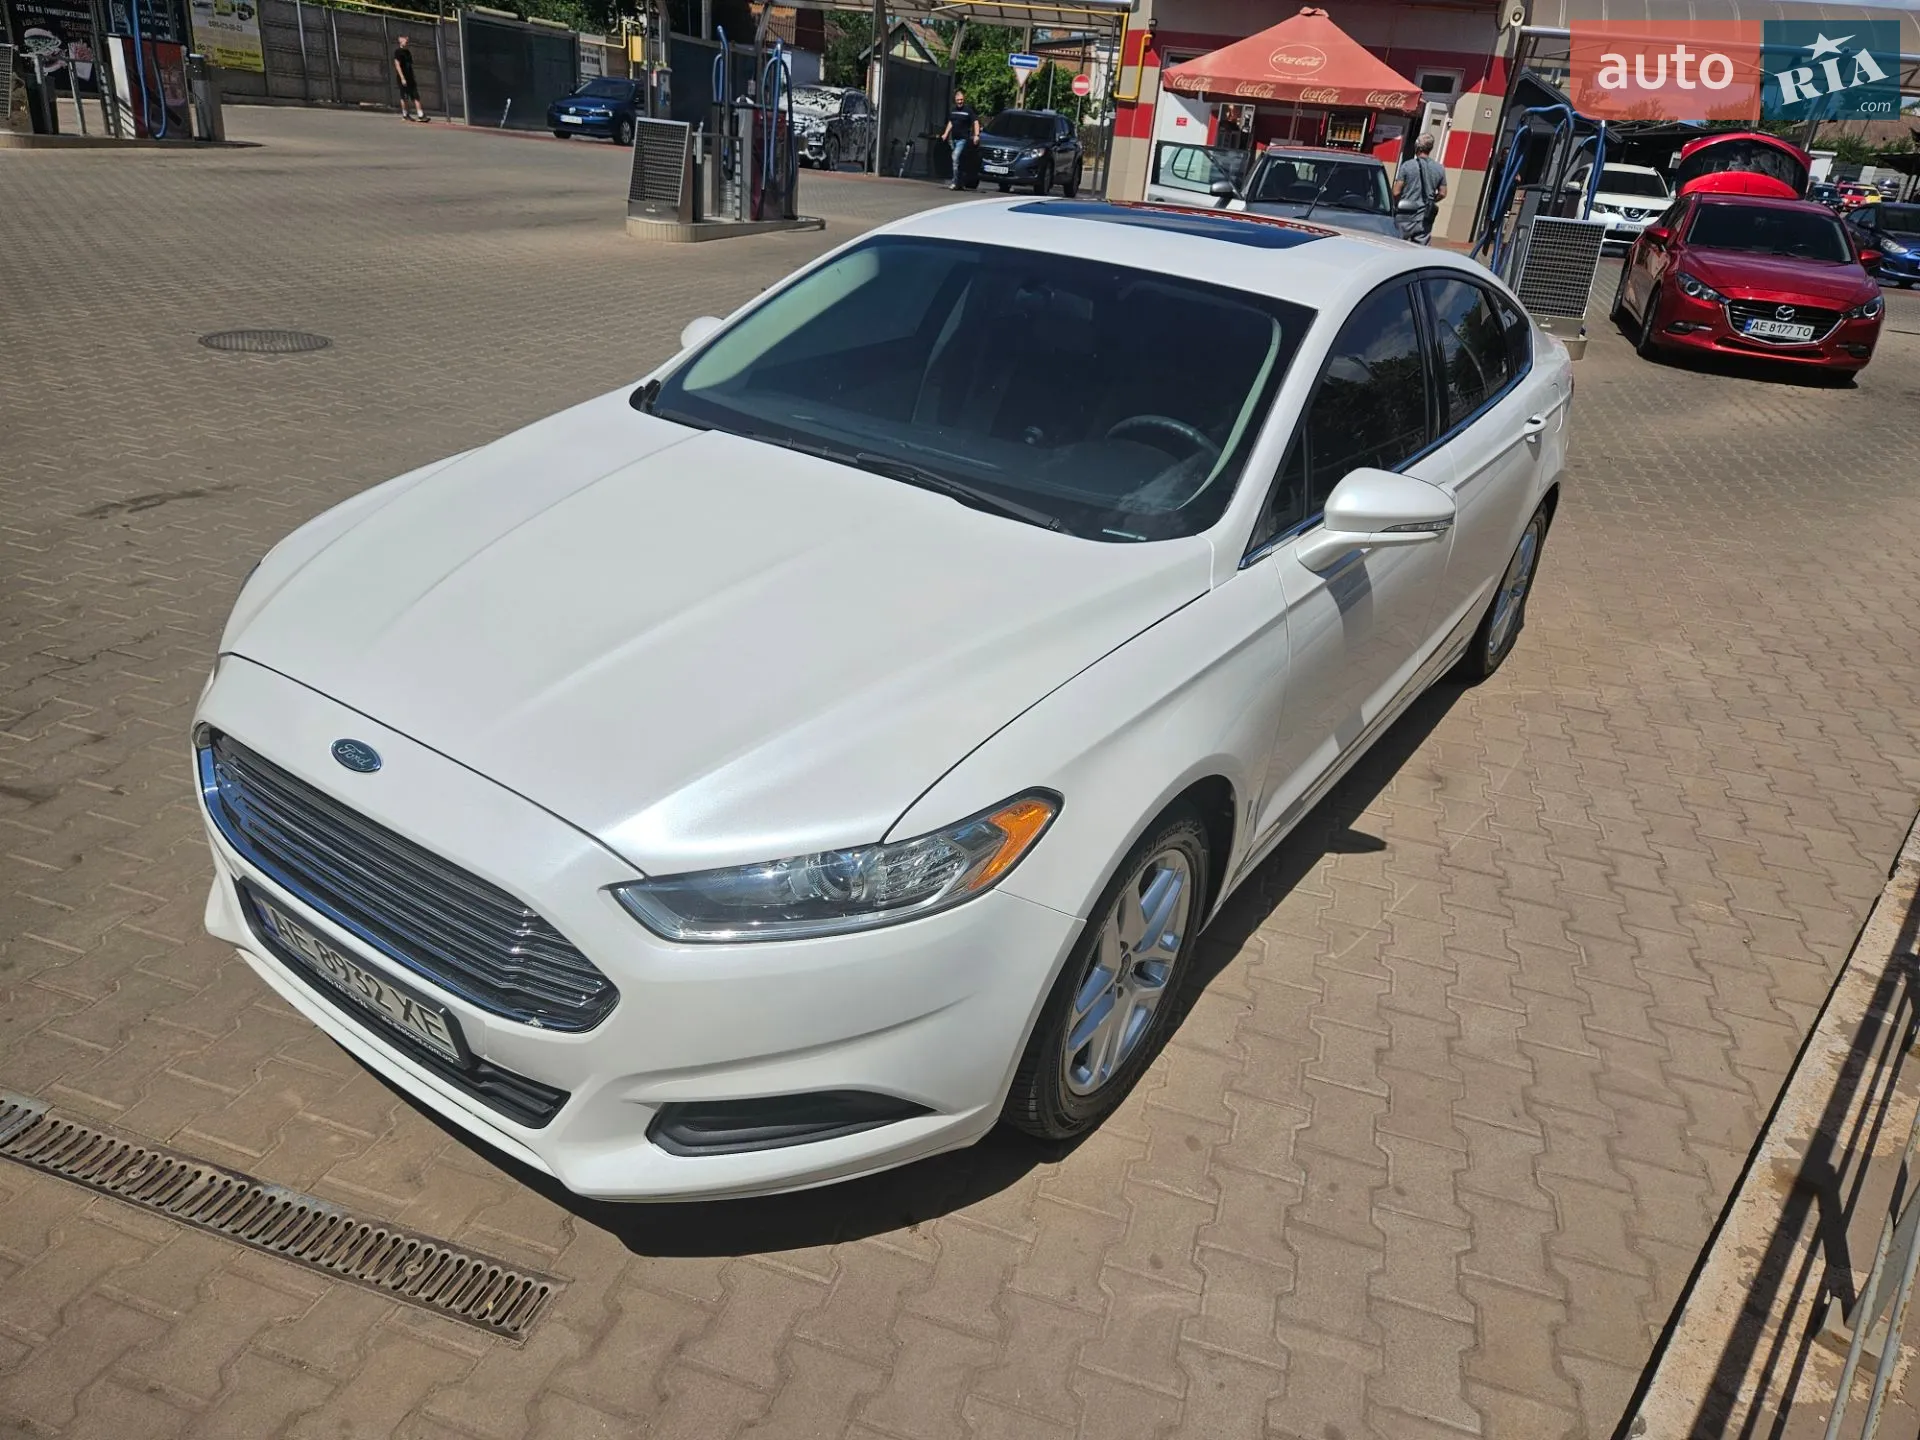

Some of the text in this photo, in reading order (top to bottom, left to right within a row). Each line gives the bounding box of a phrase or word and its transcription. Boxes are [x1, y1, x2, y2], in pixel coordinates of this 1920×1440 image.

[1752, 321, 1811, 337] AE 8177 TO
[338, 744, 371, 766] Ford
[270, 907, 317, 960] AE
[313, 938, 393, 1012] 8932
[390, 987, 452, 1047] XE
